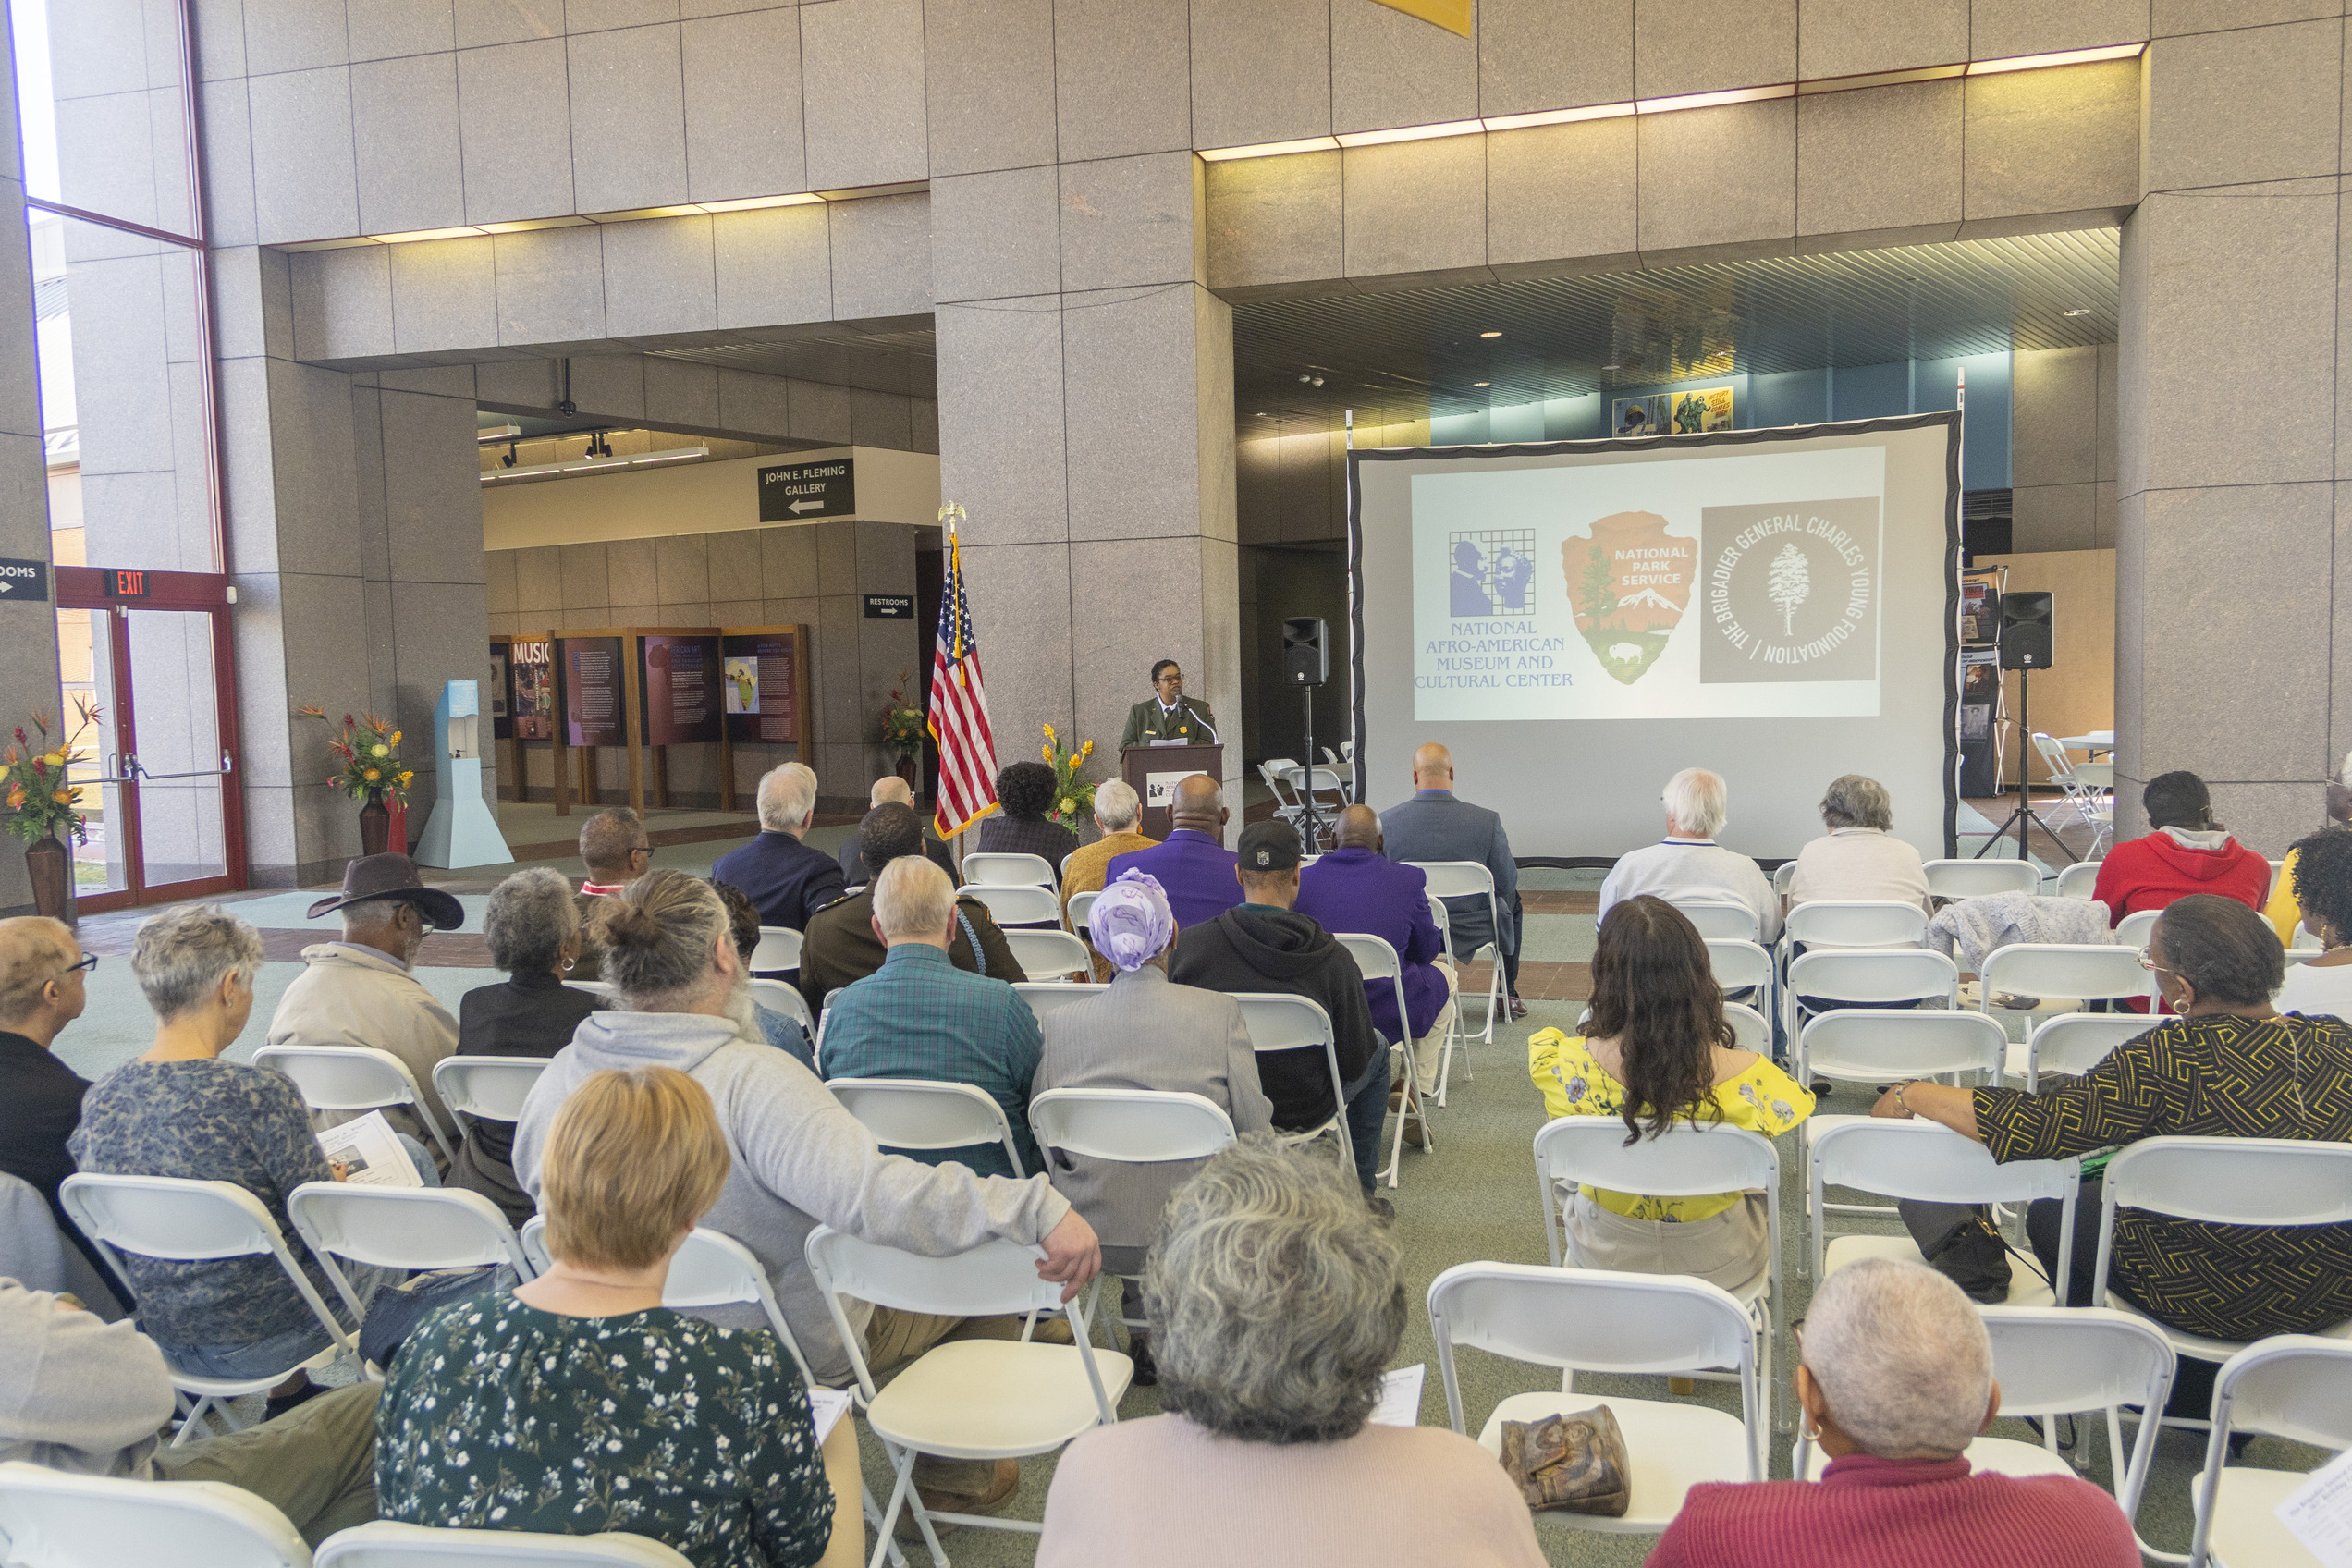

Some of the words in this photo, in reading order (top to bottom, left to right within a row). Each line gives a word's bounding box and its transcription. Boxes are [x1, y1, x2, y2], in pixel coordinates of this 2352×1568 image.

[766, 471, 790, 485] JOHN
[792, 470, 802, 480] E.
[803, 465, 845, 479] FLEMING
[785, 483, 827, 496] GALLERY
[1735, 514, 1802, 550] GENERAL
[1806, 516, 1865, 567] CHARLES
[1615, 547, 1689, 560] NATIONAL
[1633, 560, 1671, 572] PARK
[117, 570, 144, 595] EXIT
[1622, 573, 1681, 586] SERVICE
[1710, 546, 1743, 624] BRIGADIER
[1845, 567, 1870, 619] YOUNG
[1451, 621, 1537, 636] NATIONAL
[1721, 620, 1749, 650] THE
[1426, 638, 1565, 654] AFRO-AMERICAN
[1764, 619, 1856, 664] FOUNDATION
[514, 642, 549, 664] MUSIC
[1437, 656, 1511, 671] MUSEUM
[1516, 655, 1554, 669] AND
[1414, 675, 1501, 689] CULTURAL
[1505, 673, 1574, 688] CENTER
